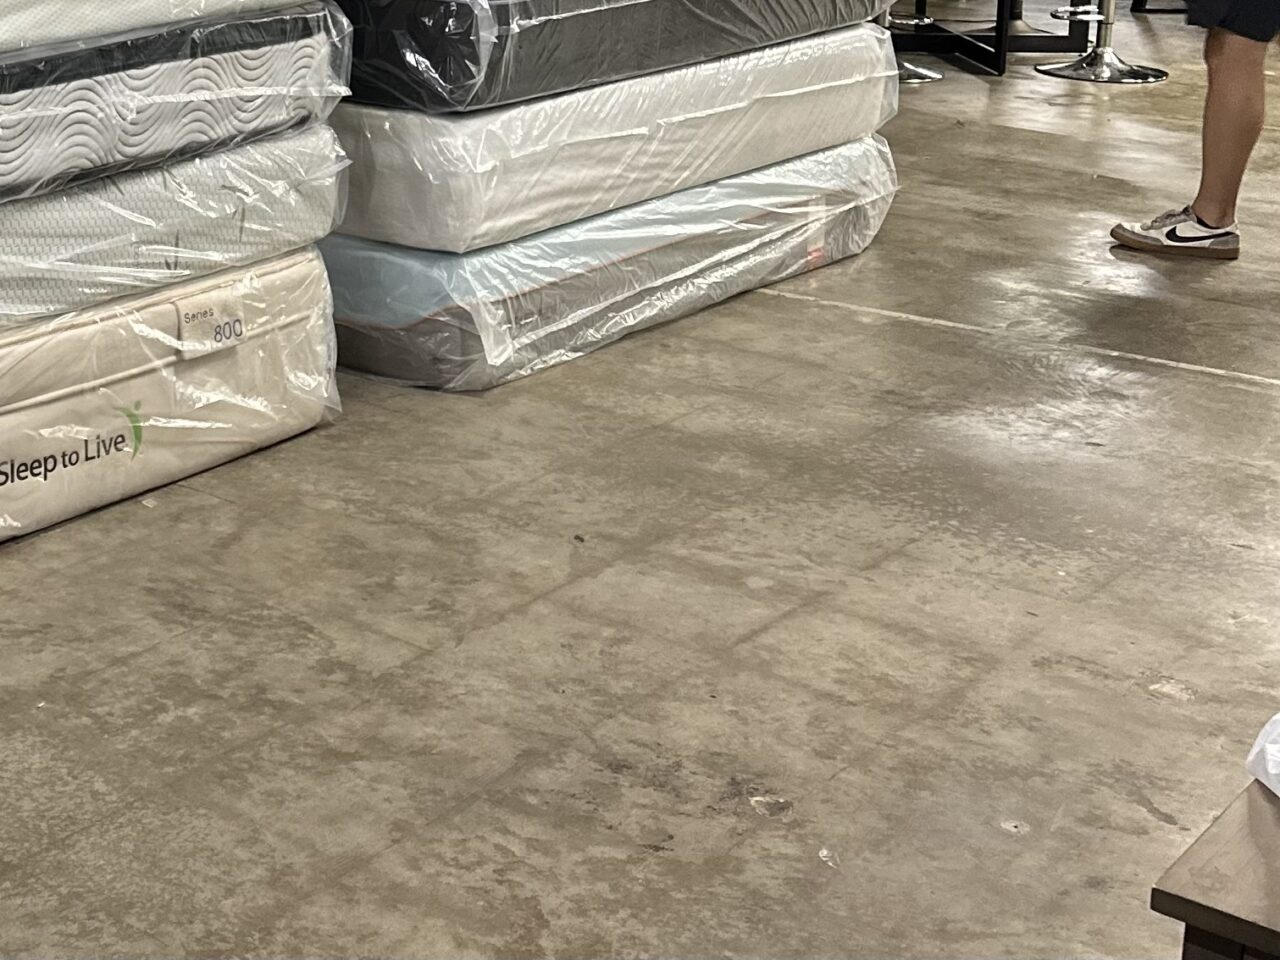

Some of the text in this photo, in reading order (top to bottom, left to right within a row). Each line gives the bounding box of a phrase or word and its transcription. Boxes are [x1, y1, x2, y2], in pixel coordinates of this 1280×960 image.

[184, 307, 214, 324] Series
[214, 318, 243, 343] 800
[60, 450, 80, 469] to
[83, 433, 126, 462] Live
